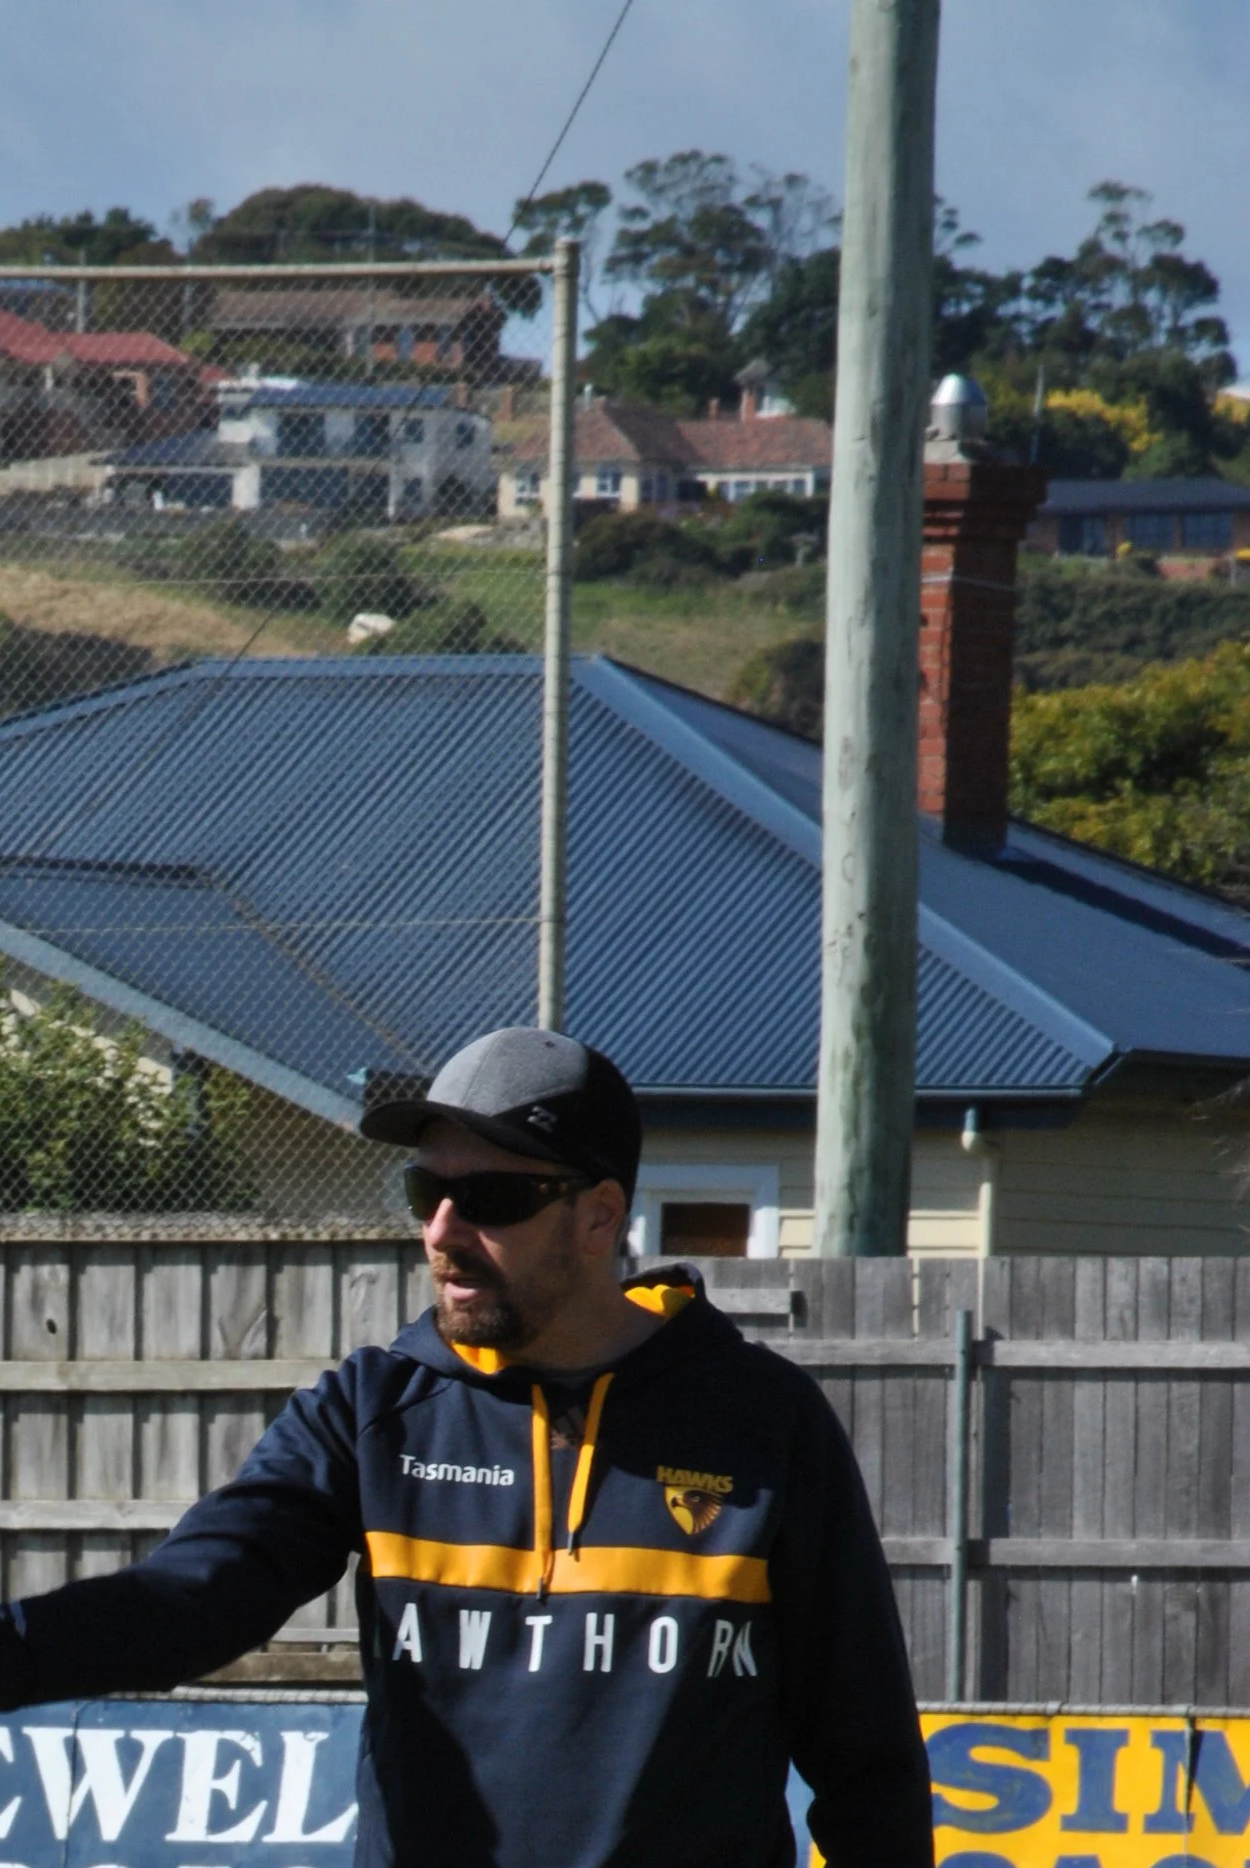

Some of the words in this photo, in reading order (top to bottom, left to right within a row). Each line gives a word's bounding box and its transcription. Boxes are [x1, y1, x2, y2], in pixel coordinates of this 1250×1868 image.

[400, 1454, 514, 1487] Tasmania
[656, 1465, 734, 1494] HAWKS
[373, 1603, 758, 1678] AWTHORN
